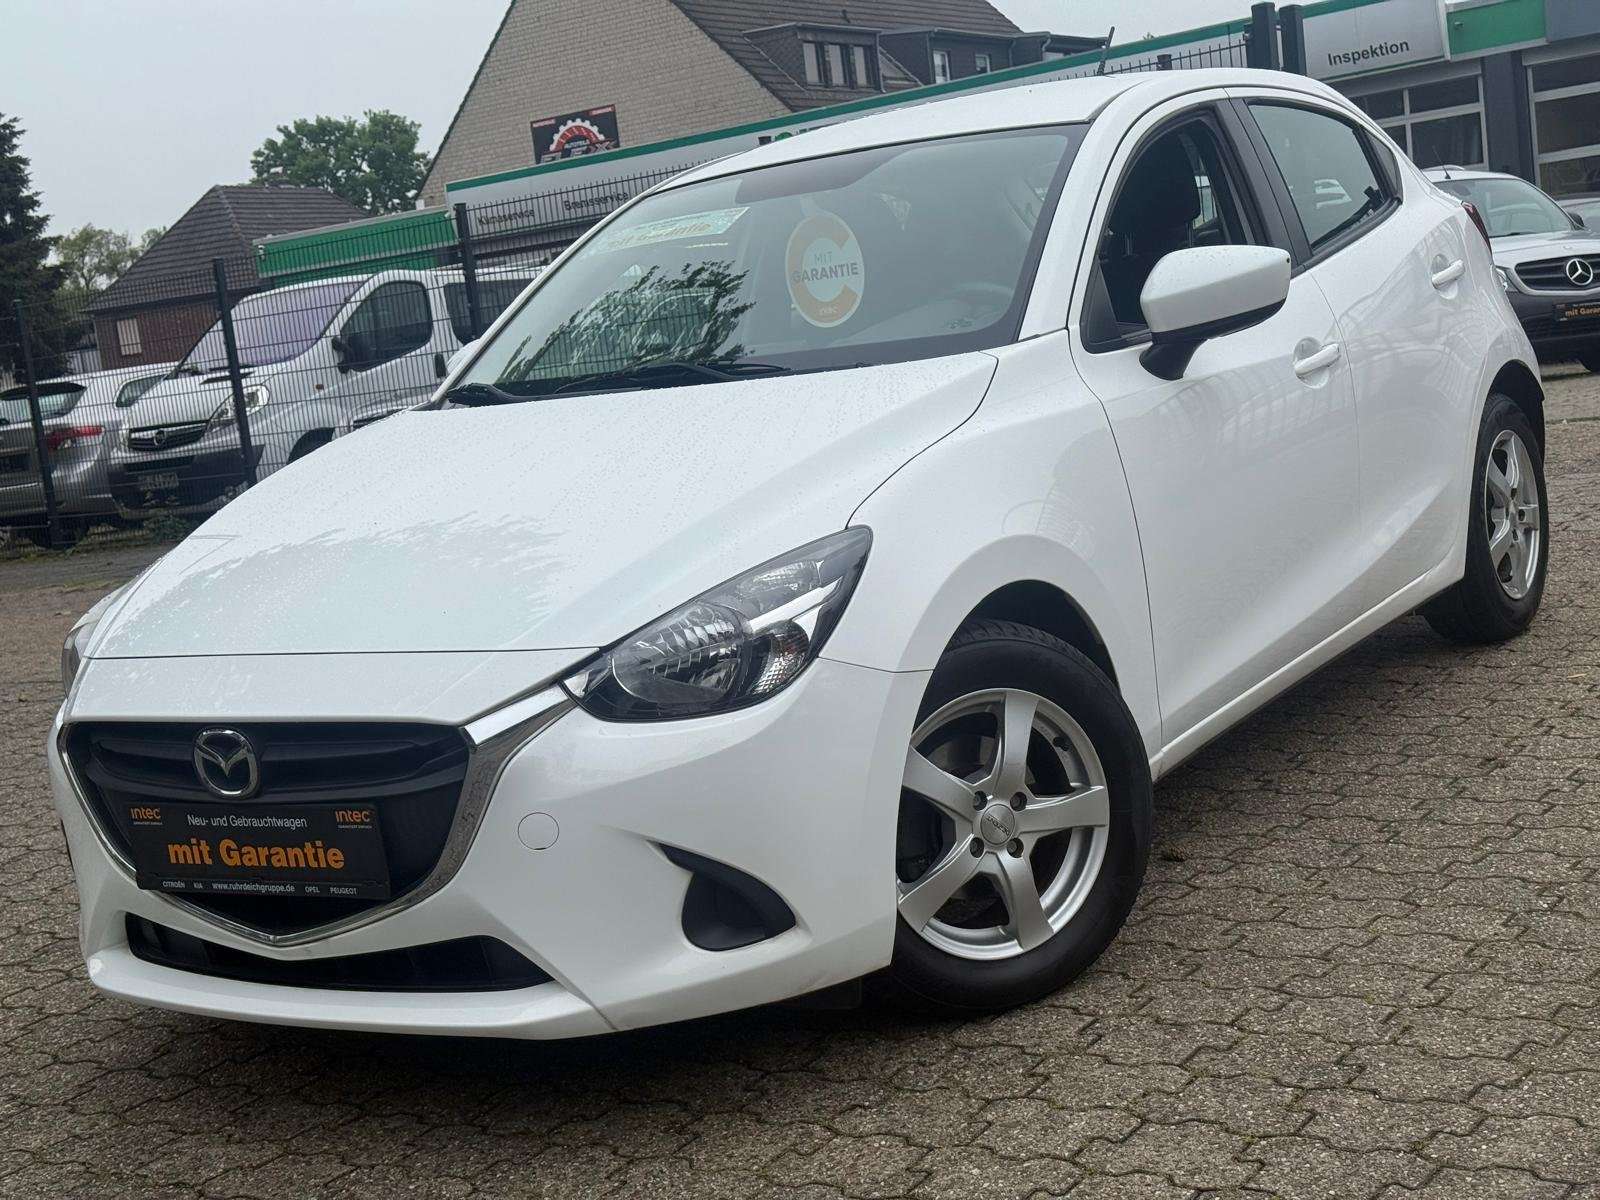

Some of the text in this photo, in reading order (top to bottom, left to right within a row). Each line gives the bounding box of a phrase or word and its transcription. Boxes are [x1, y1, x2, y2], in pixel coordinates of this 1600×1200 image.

[1327, 40, 1410, 66] Inspektion
[478, 209, 535, 226] Klimaservice
[813, 250, 834, 266] MIT
[791, 262, 859, 283] GARANTIE
[130, 807, 162, 820] intec
[335, 810, 371, 823] intec
[187, 814, 307, 830] Neu- und Gebrauchtwagen
[167, 837, 346, 870] mit Garantie
[193, 882, 203, 890] KIA
[212, 882, 296, 893] www.ruhrdeichgruppe.de
[305, 885, 320, 894] OPEL
[330, 887, 358, 896] PEUGEOT
